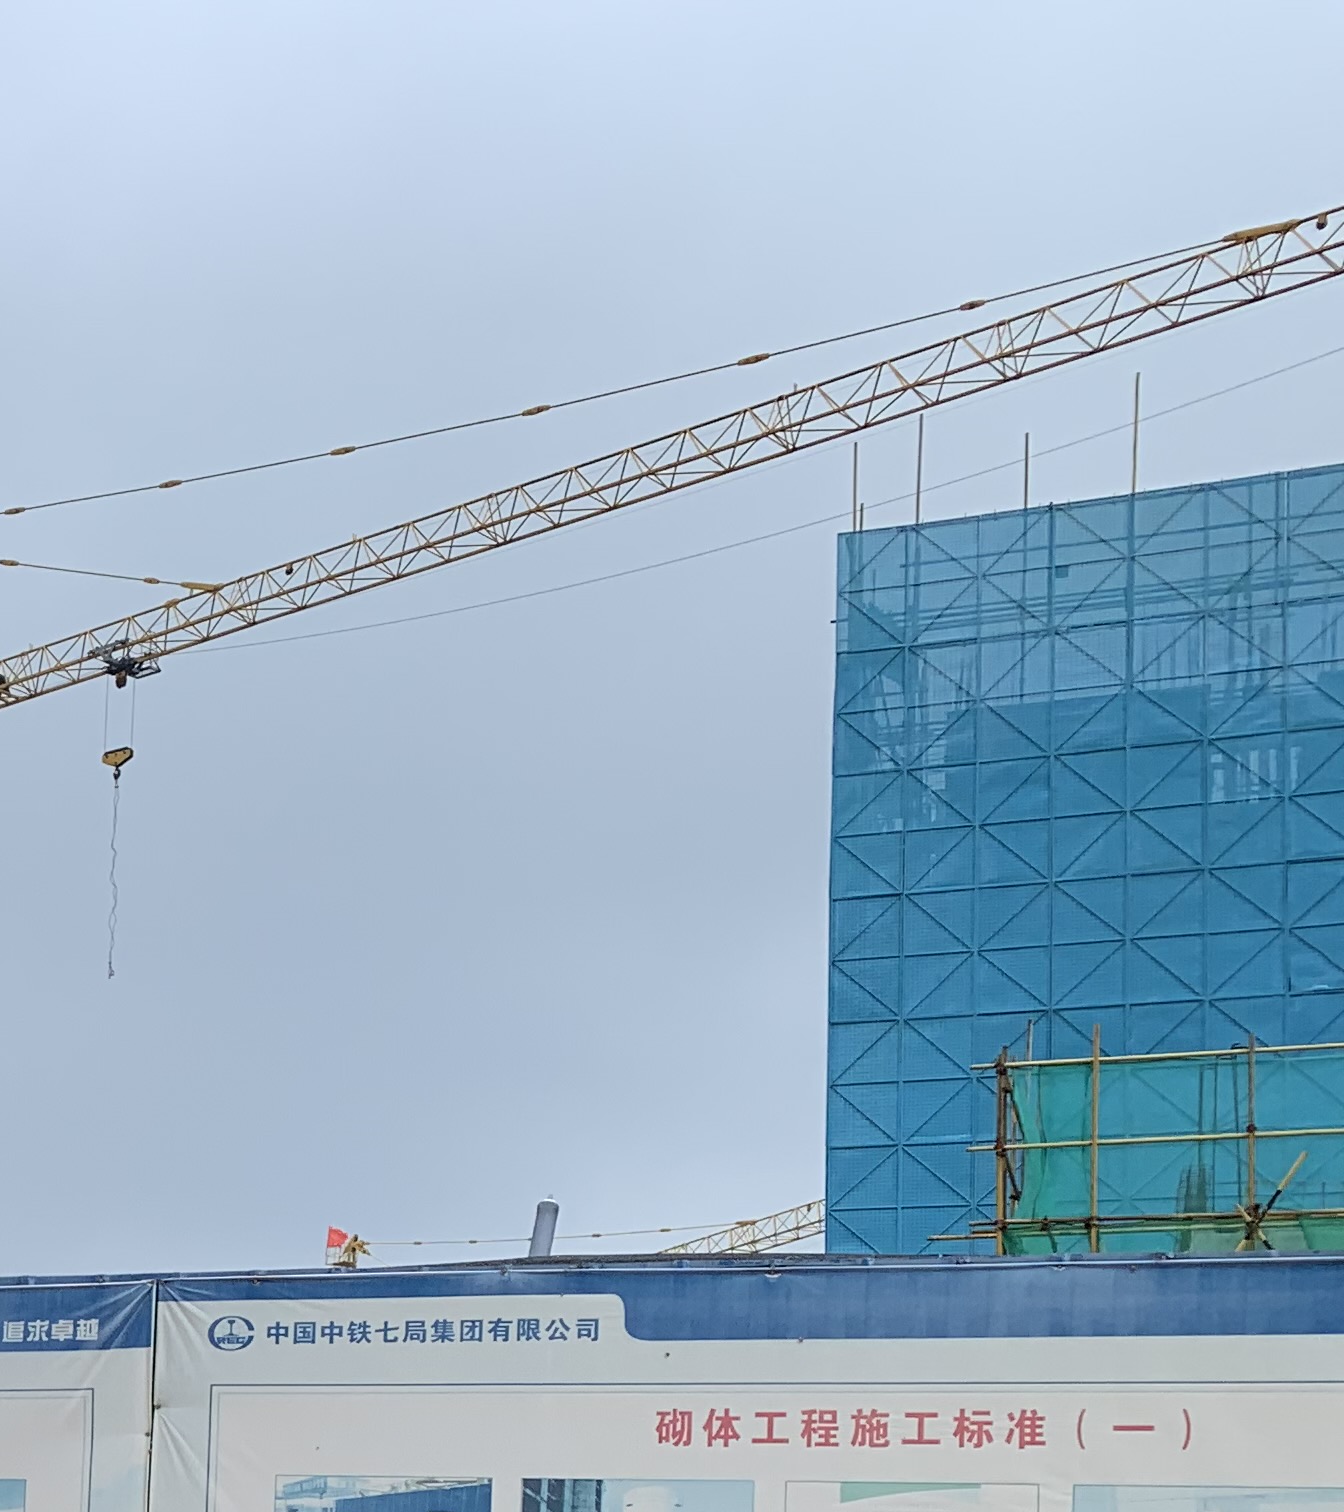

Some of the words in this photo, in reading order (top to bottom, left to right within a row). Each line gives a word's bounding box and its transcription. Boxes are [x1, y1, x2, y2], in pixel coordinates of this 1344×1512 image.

[1, 1318, 100, 1343] 追求卓越
[266, 1317, 601, 1346] 中国中铁七局集团有限公司
[655, 1407, 1193, 1450] 砌体工程施工标准（一）
